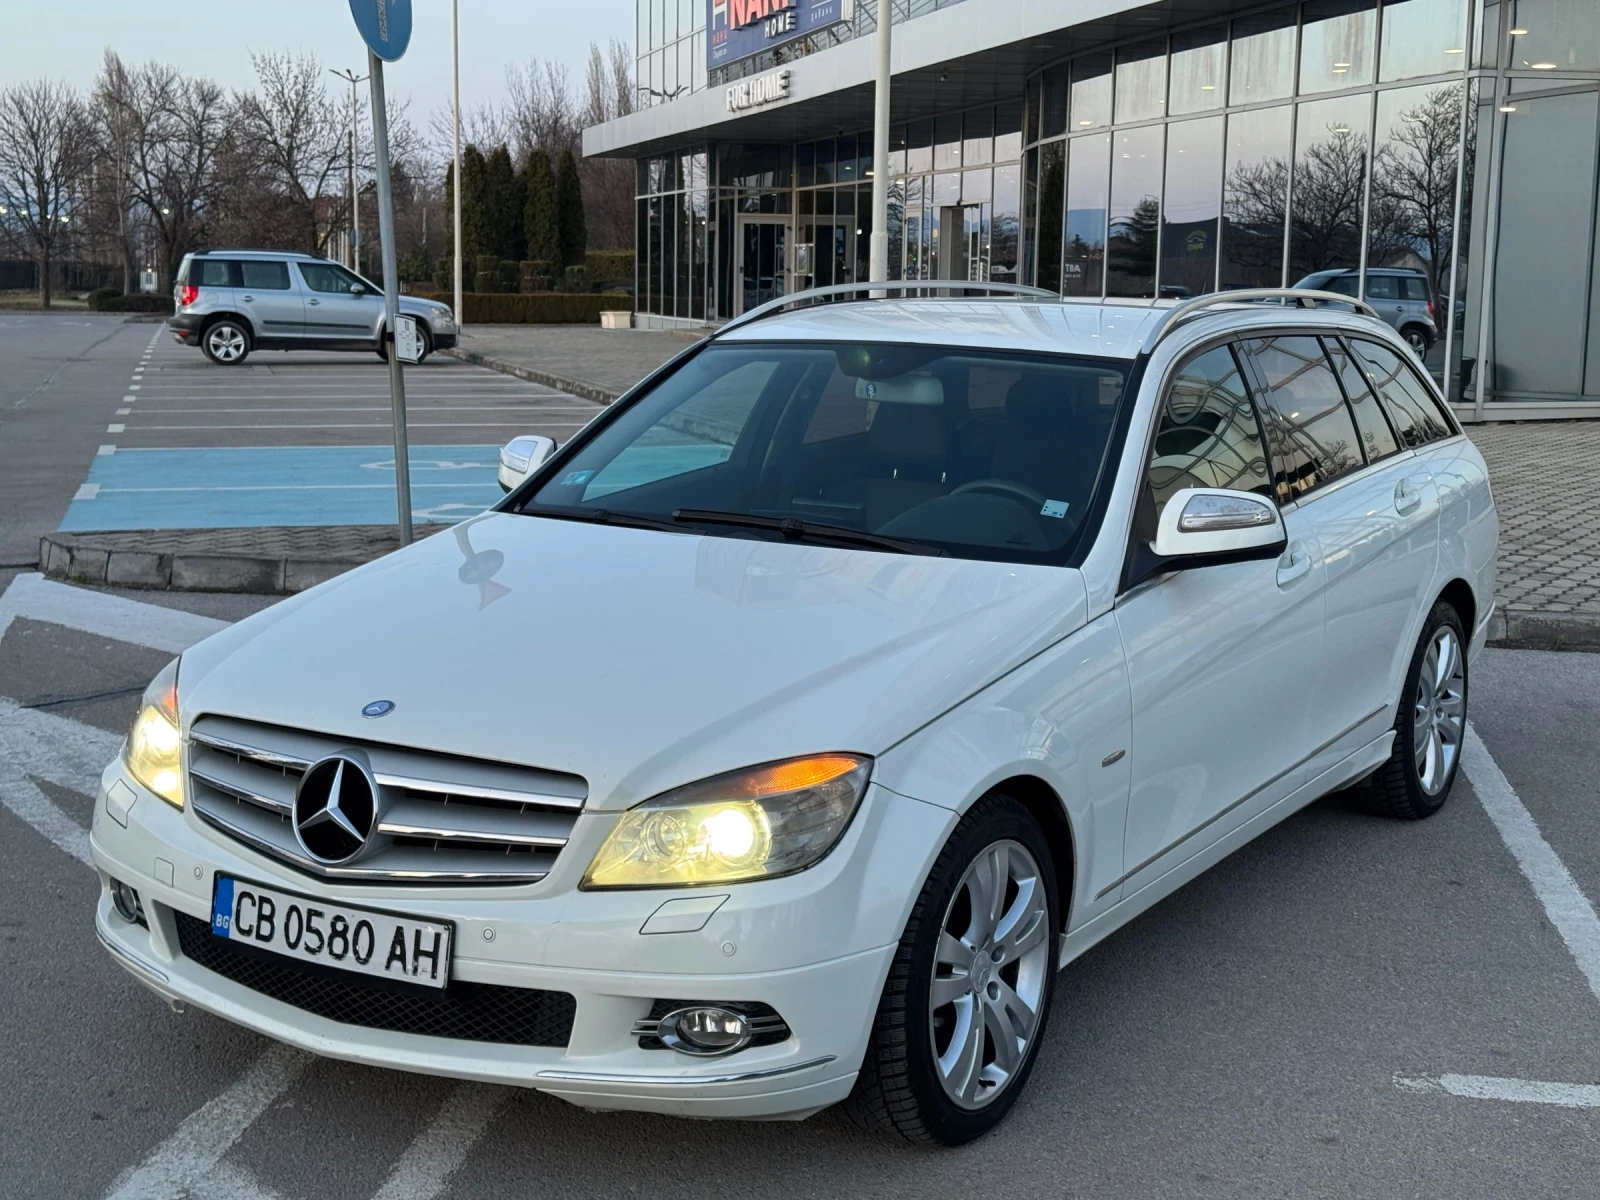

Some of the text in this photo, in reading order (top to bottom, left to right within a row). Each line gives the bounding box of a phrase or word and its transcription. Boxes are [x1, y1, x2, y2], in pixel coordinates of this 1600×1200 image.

[730, 0, 789, 30] NA
[764, 11, 793, 38] HOME
[726, 70, 790, 112] FOR HOME
[216, 913, 230, 929] BG
[235, 891, 441, 980] CB 0580 AH
